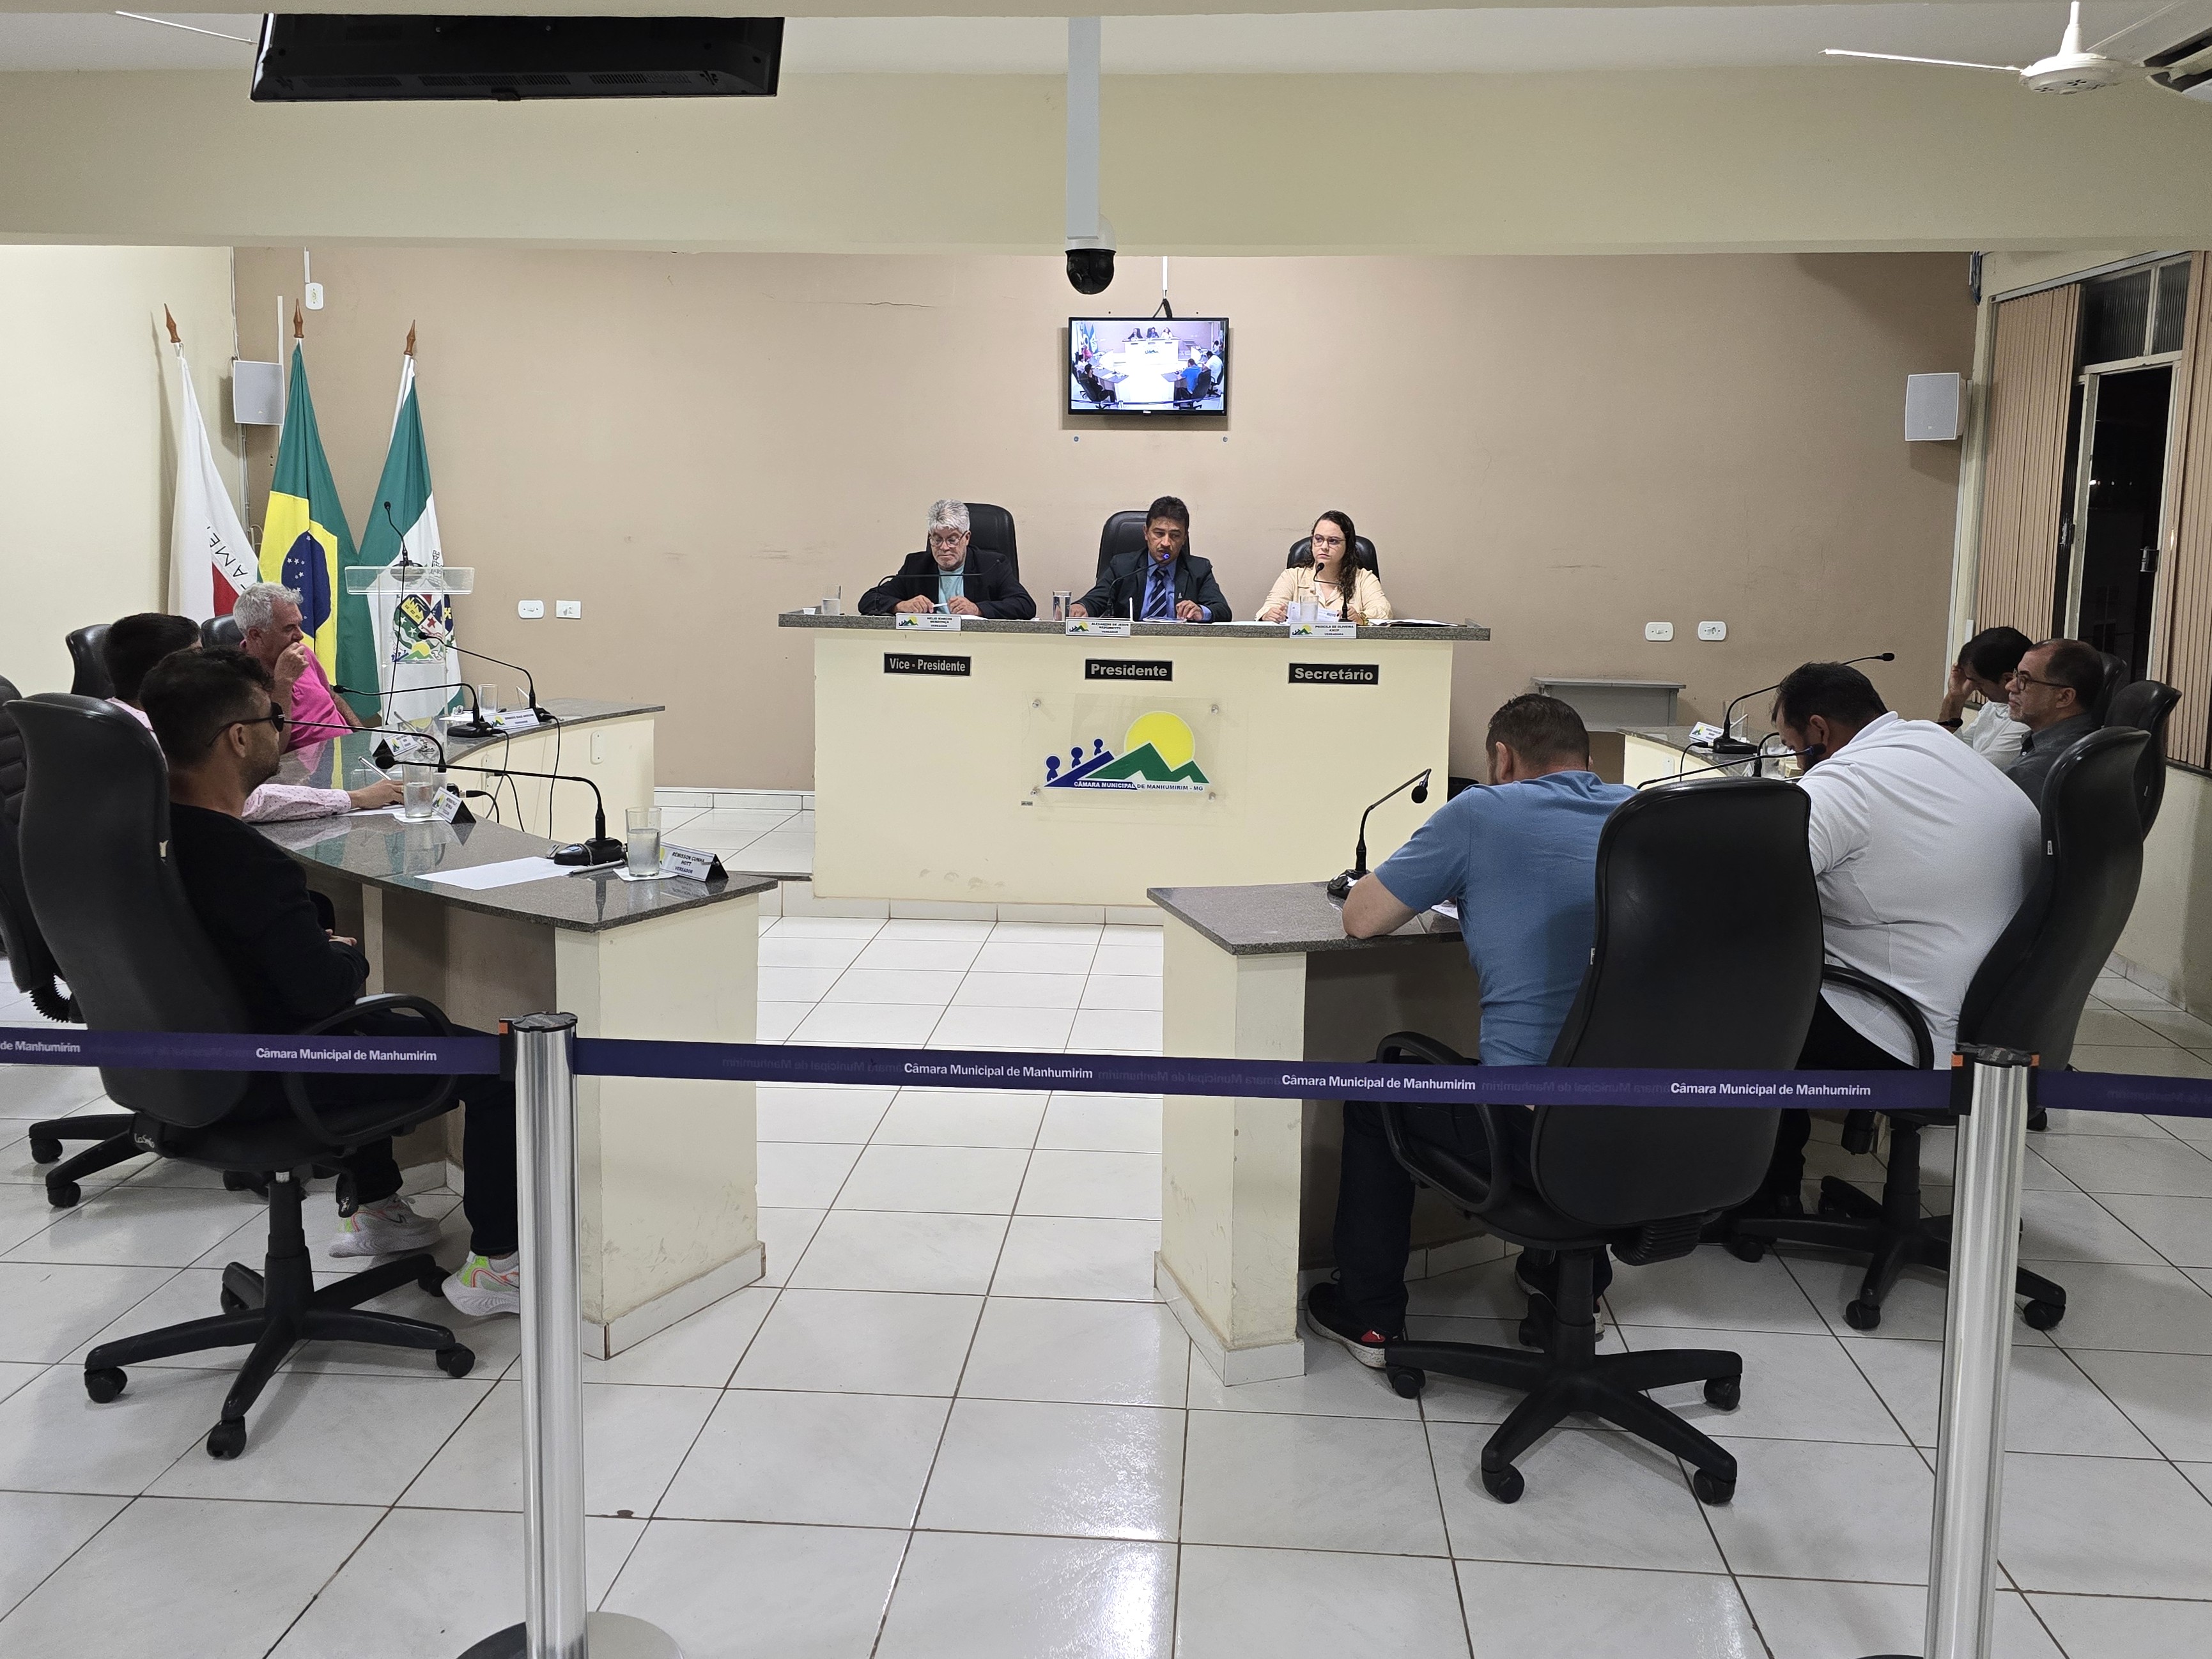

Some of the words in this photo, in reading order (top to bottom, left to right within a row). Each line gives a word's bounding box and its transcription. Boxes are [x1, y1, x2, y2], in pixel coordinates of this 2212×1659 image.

[206, 526, 249, 590] AME
[889, 658, 910, 670] Vice
[917, 659, 966, 672] Presidente
[1091, 663, 1168, 677] Presidente
[1294, 667, 1373, 681] Secretário
[0, 1041, 13, 1051] de
[15, 1041, 81, 1053] Manhumirim
[256, 1047, 298, 1059] Câmara
[300, 1049, 352, 1061] Municipal
[353, 1049, 367, 1060] de
[369, 1050, 437, 1061] Manhumirim
[904, 1063, 947, 1074] Câmara
[950, 1064, 1004, 1077] Municipal
[1007, 1066, 1021, 1076] de
[1023, 1067, 1093, 1078] Manhumirim
[1281, 1074, 1326, 1086] Câmara
[1329, 1076, 1384, 1090] Municipal
[1386, 1077, 1401, 1088] de
[1404, 1077, 1476, 1090] Manhumirim
[1671, 1083, 1717, 1094] Câmara
[1719, 1083, 1776, 1097] Municipal
[1779, 1084, 1793, 1095] de
[1796, 1084, 1871, 1095] Manhumirim
